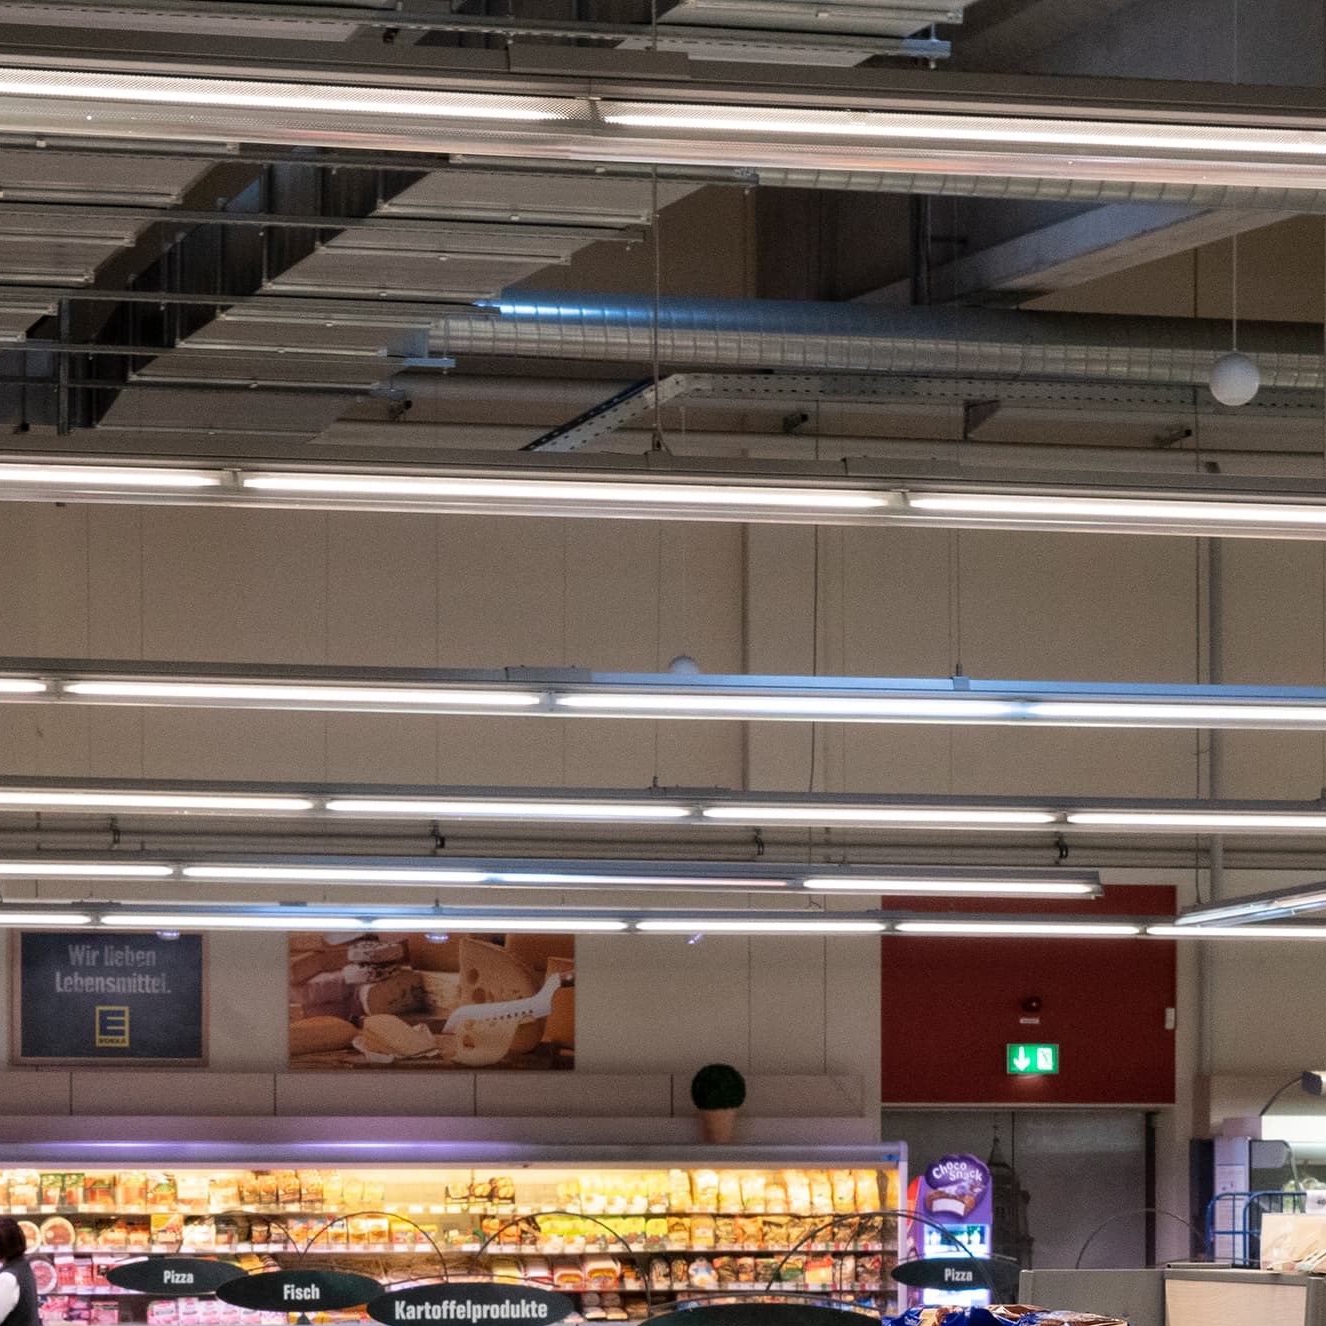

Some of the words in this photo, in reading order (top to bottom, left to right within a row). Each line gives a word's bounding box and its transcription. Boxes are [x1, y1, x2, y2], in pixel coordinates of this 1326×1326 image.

[68, 944, 100, 967] Wir
[104, 944, 157, 967] lieben
[55, 971, 172, 994] Lebensmittel.
[932, 1159, 968, 1180] Choco
[948, 1166, 984, 1183] Snack
[163, 1269, 195, 1285] Pizza
[943, 1267, 973, 1283] Pizza
[283, 1283, 320, 1301] Fisch
[394, 1300, 548, 1324] Kartoffelprodukte
